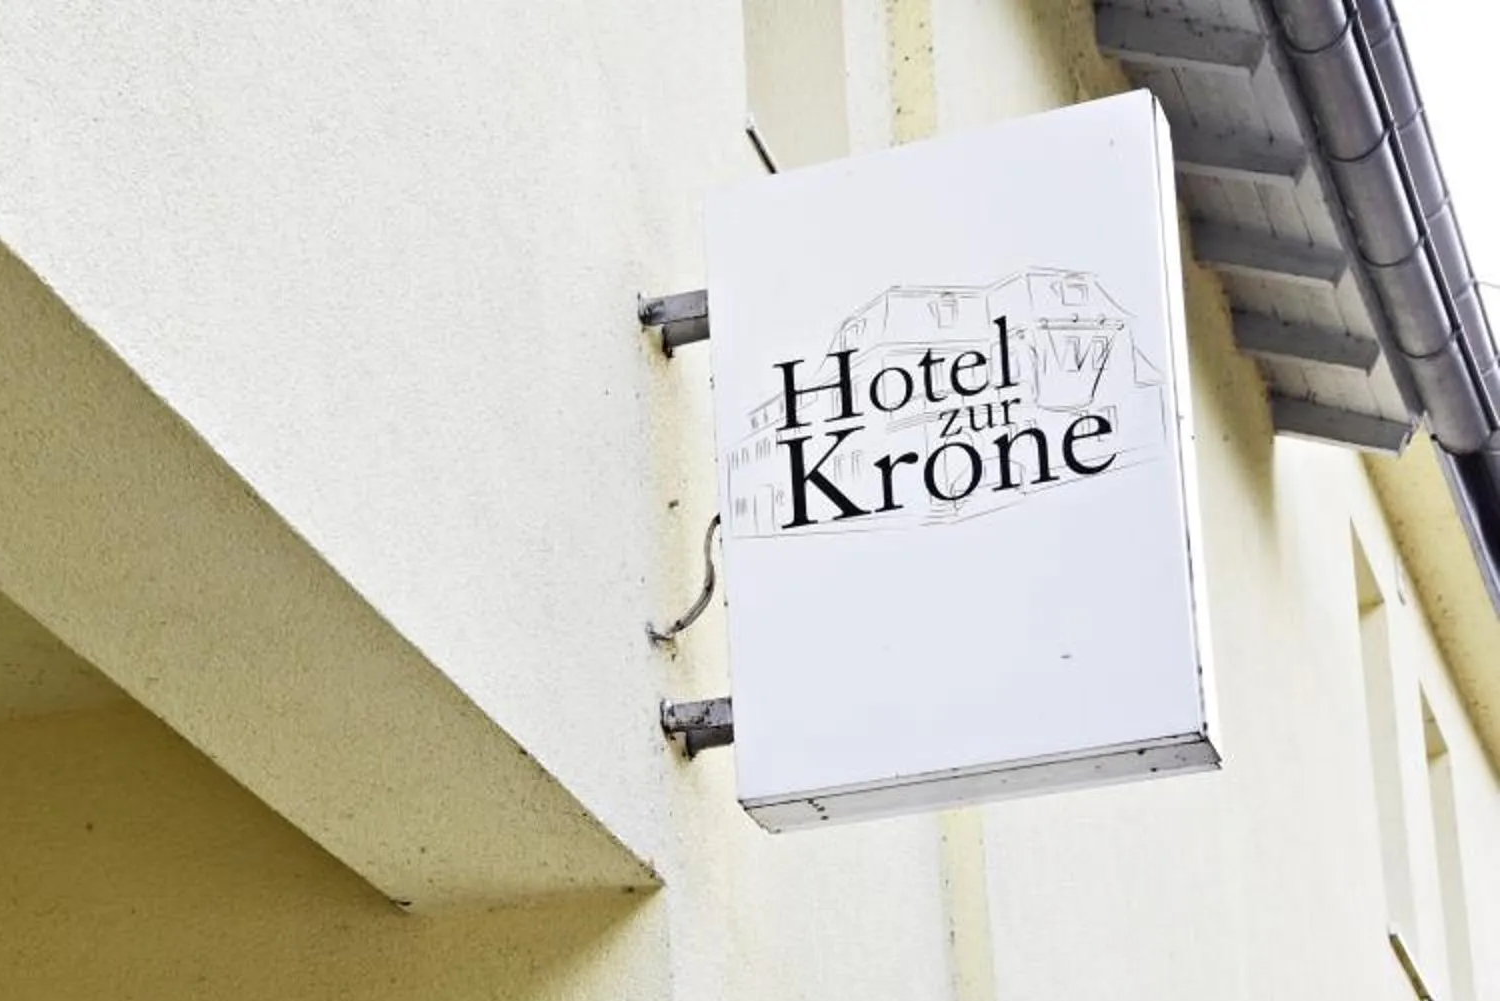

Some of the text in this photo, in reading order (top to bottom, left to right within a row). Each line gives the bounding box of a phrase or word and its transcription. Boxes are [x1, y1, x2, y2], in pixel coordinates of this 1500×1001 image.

[773, 315, 1019, 432] Hotel
[938, 397, 1021, 439] zur
[776, 411, 1118, 530] Krone
